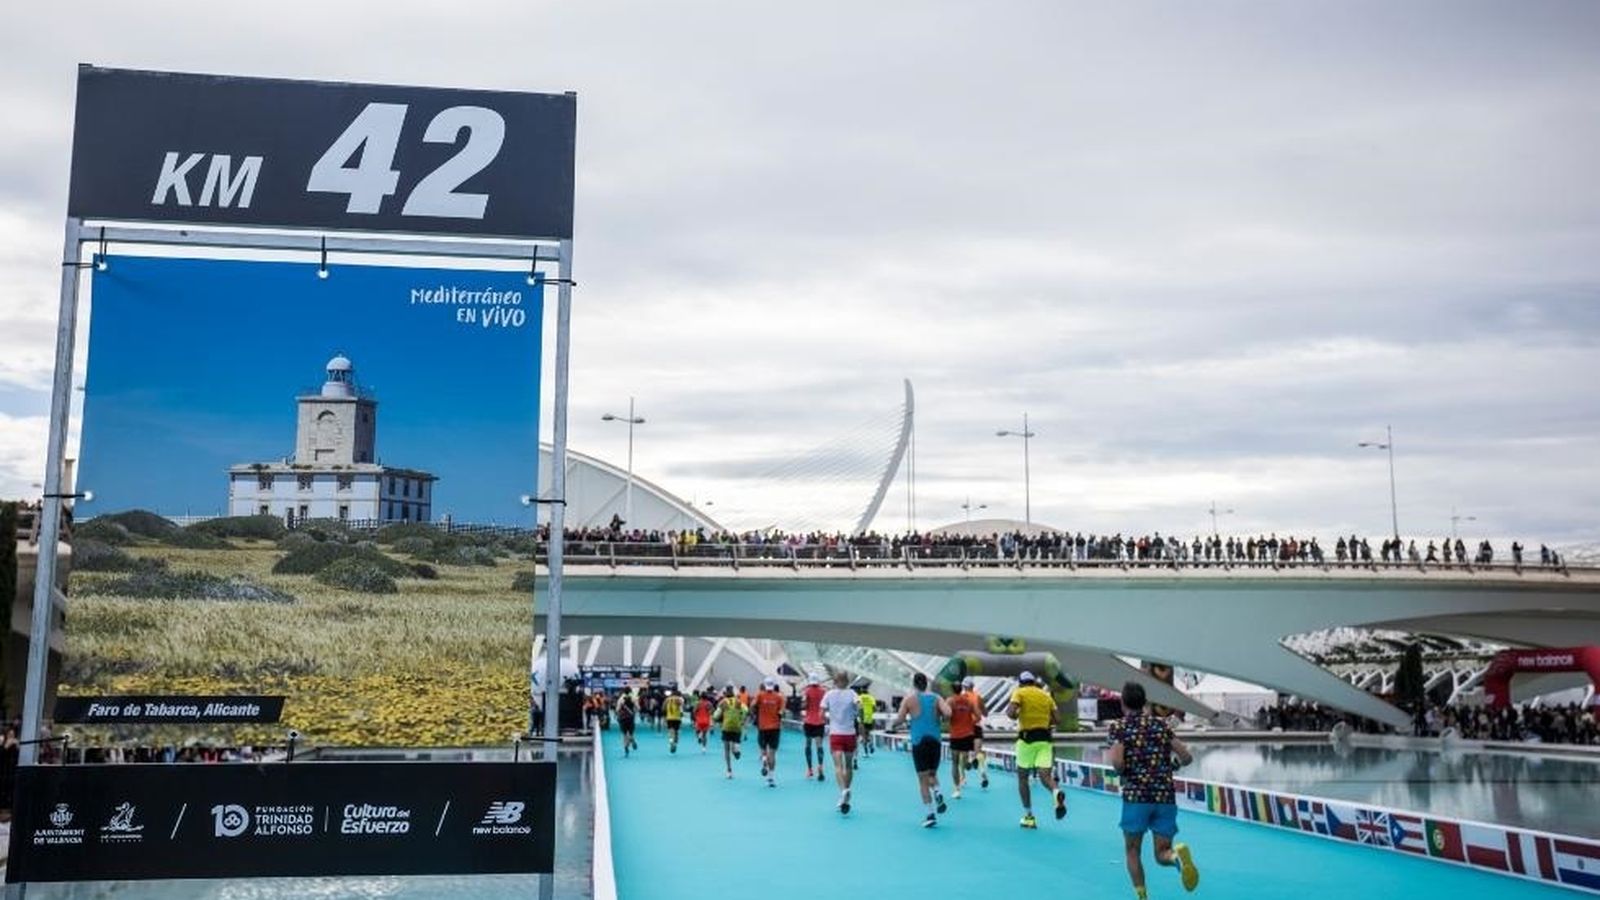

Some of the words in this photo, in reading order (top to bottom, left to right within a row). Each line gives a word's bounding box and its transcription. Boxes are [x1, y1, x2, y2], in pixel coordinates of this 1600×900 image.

[151, 151, 264, 208] KM
[306, 102, 506, 219] 42
[457, 308, 477, 323] EN
[88, 704, 119, 716] Faro
[123, 704, 140, 716] de
[145, 703, 201, 719] Tabarca,
[203, 703, 260, 716] Alicante
[256, 805, 314, 813] FUNDACIÓN
[344, 803, 397, 818] Cultura
[254, 814, 313, 824] TRINIDAD
[341, 818, 410, 834] Esfuerzo
[254, 824, 313, 835] ALFONSO
[473, 826, 492, 835] new
[492, 825, 532, 835] balance
